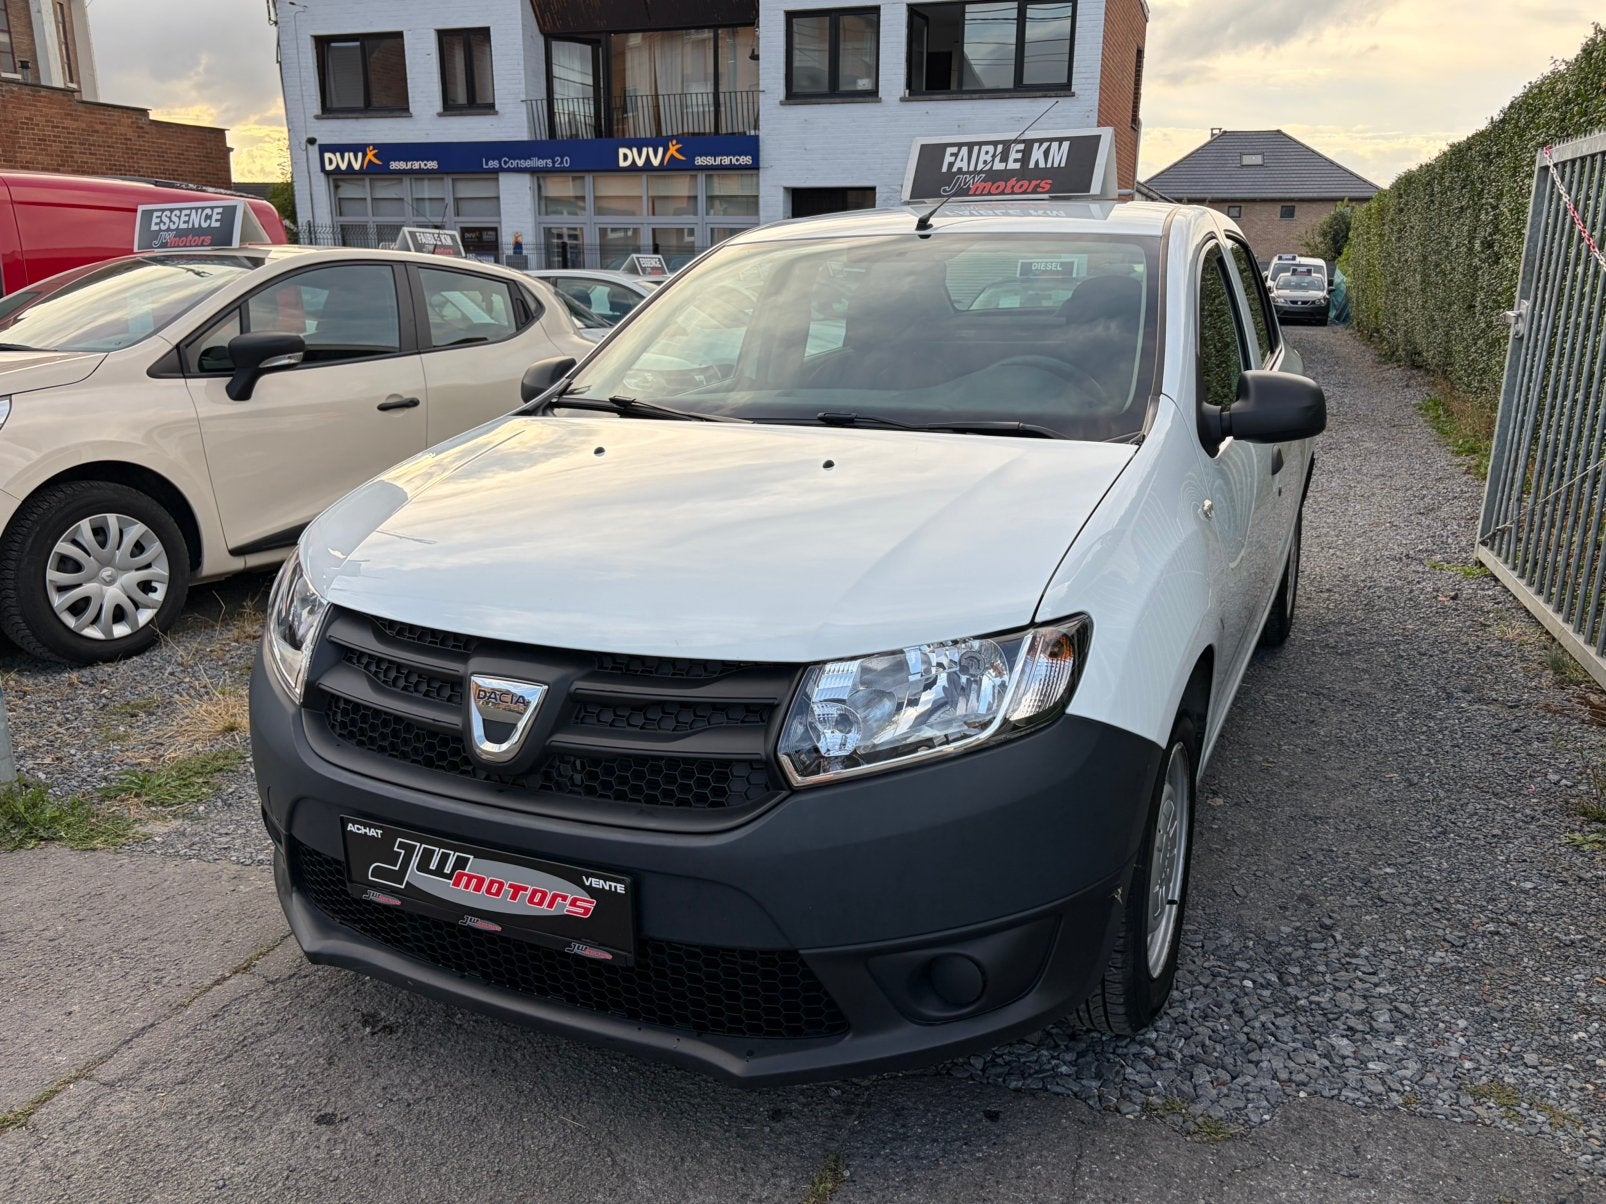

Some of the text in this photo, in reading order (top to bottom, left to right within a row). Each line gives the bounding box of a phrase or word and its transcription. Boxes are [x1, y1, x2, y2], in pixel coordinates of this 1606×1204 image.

[324, 152, 438, 170] DVV assurances
[482, 156, 570, 168] Les Conseillers 2.0
[618, 147, 752, 167] DVV assurances
[941, 141, 1070, 172] FAIBLE KM
[941, 174, 1053, 196] JW motors
[150, 207, 223, 230] ESSENCE
[167, 234, 212, 247] motors
[415, 232, 453, 246] FAIBLE KM
[1031, 262, 1062, 271] DIESEL
[477, 689, 527, 706] DACIA
[347, 823, 383, 838] ACHAT
[368, 838, 474, 888] JW
[582, 875, 626, 894] VENTE
